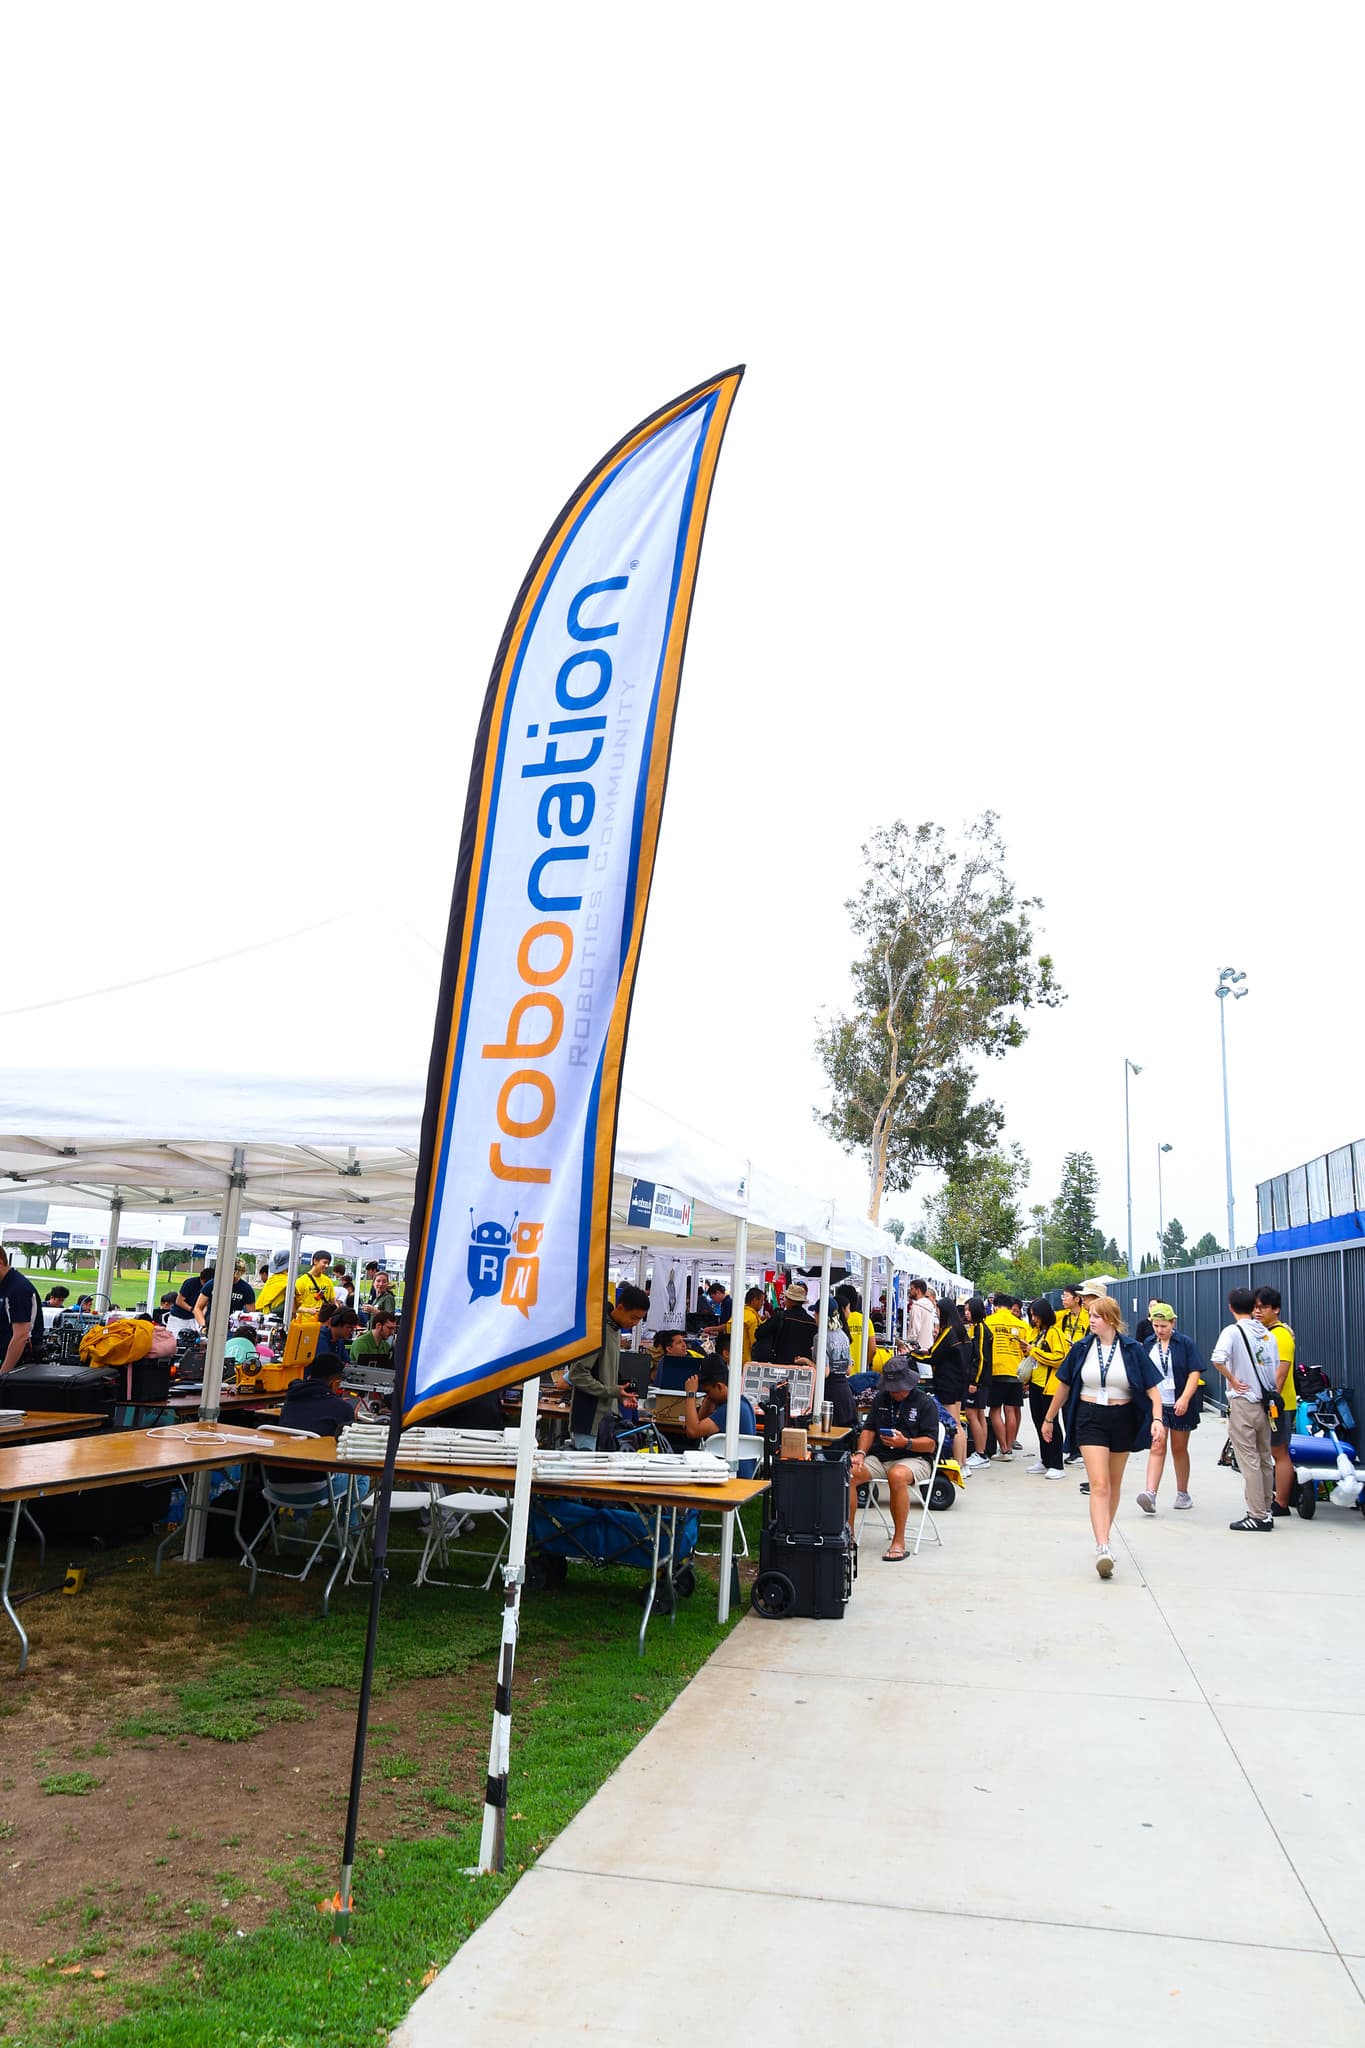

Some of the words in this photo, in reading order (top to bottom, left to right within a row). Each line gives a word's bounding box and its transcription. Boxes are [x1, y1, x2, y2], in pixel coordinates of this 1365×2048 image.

[568, 890, 603, 1068] ROBOTICS
[594, 679, 636, 873] COMMUNITY
[479, 1254, 499, 1281] R
[510, 1265, 531, 1299] N
